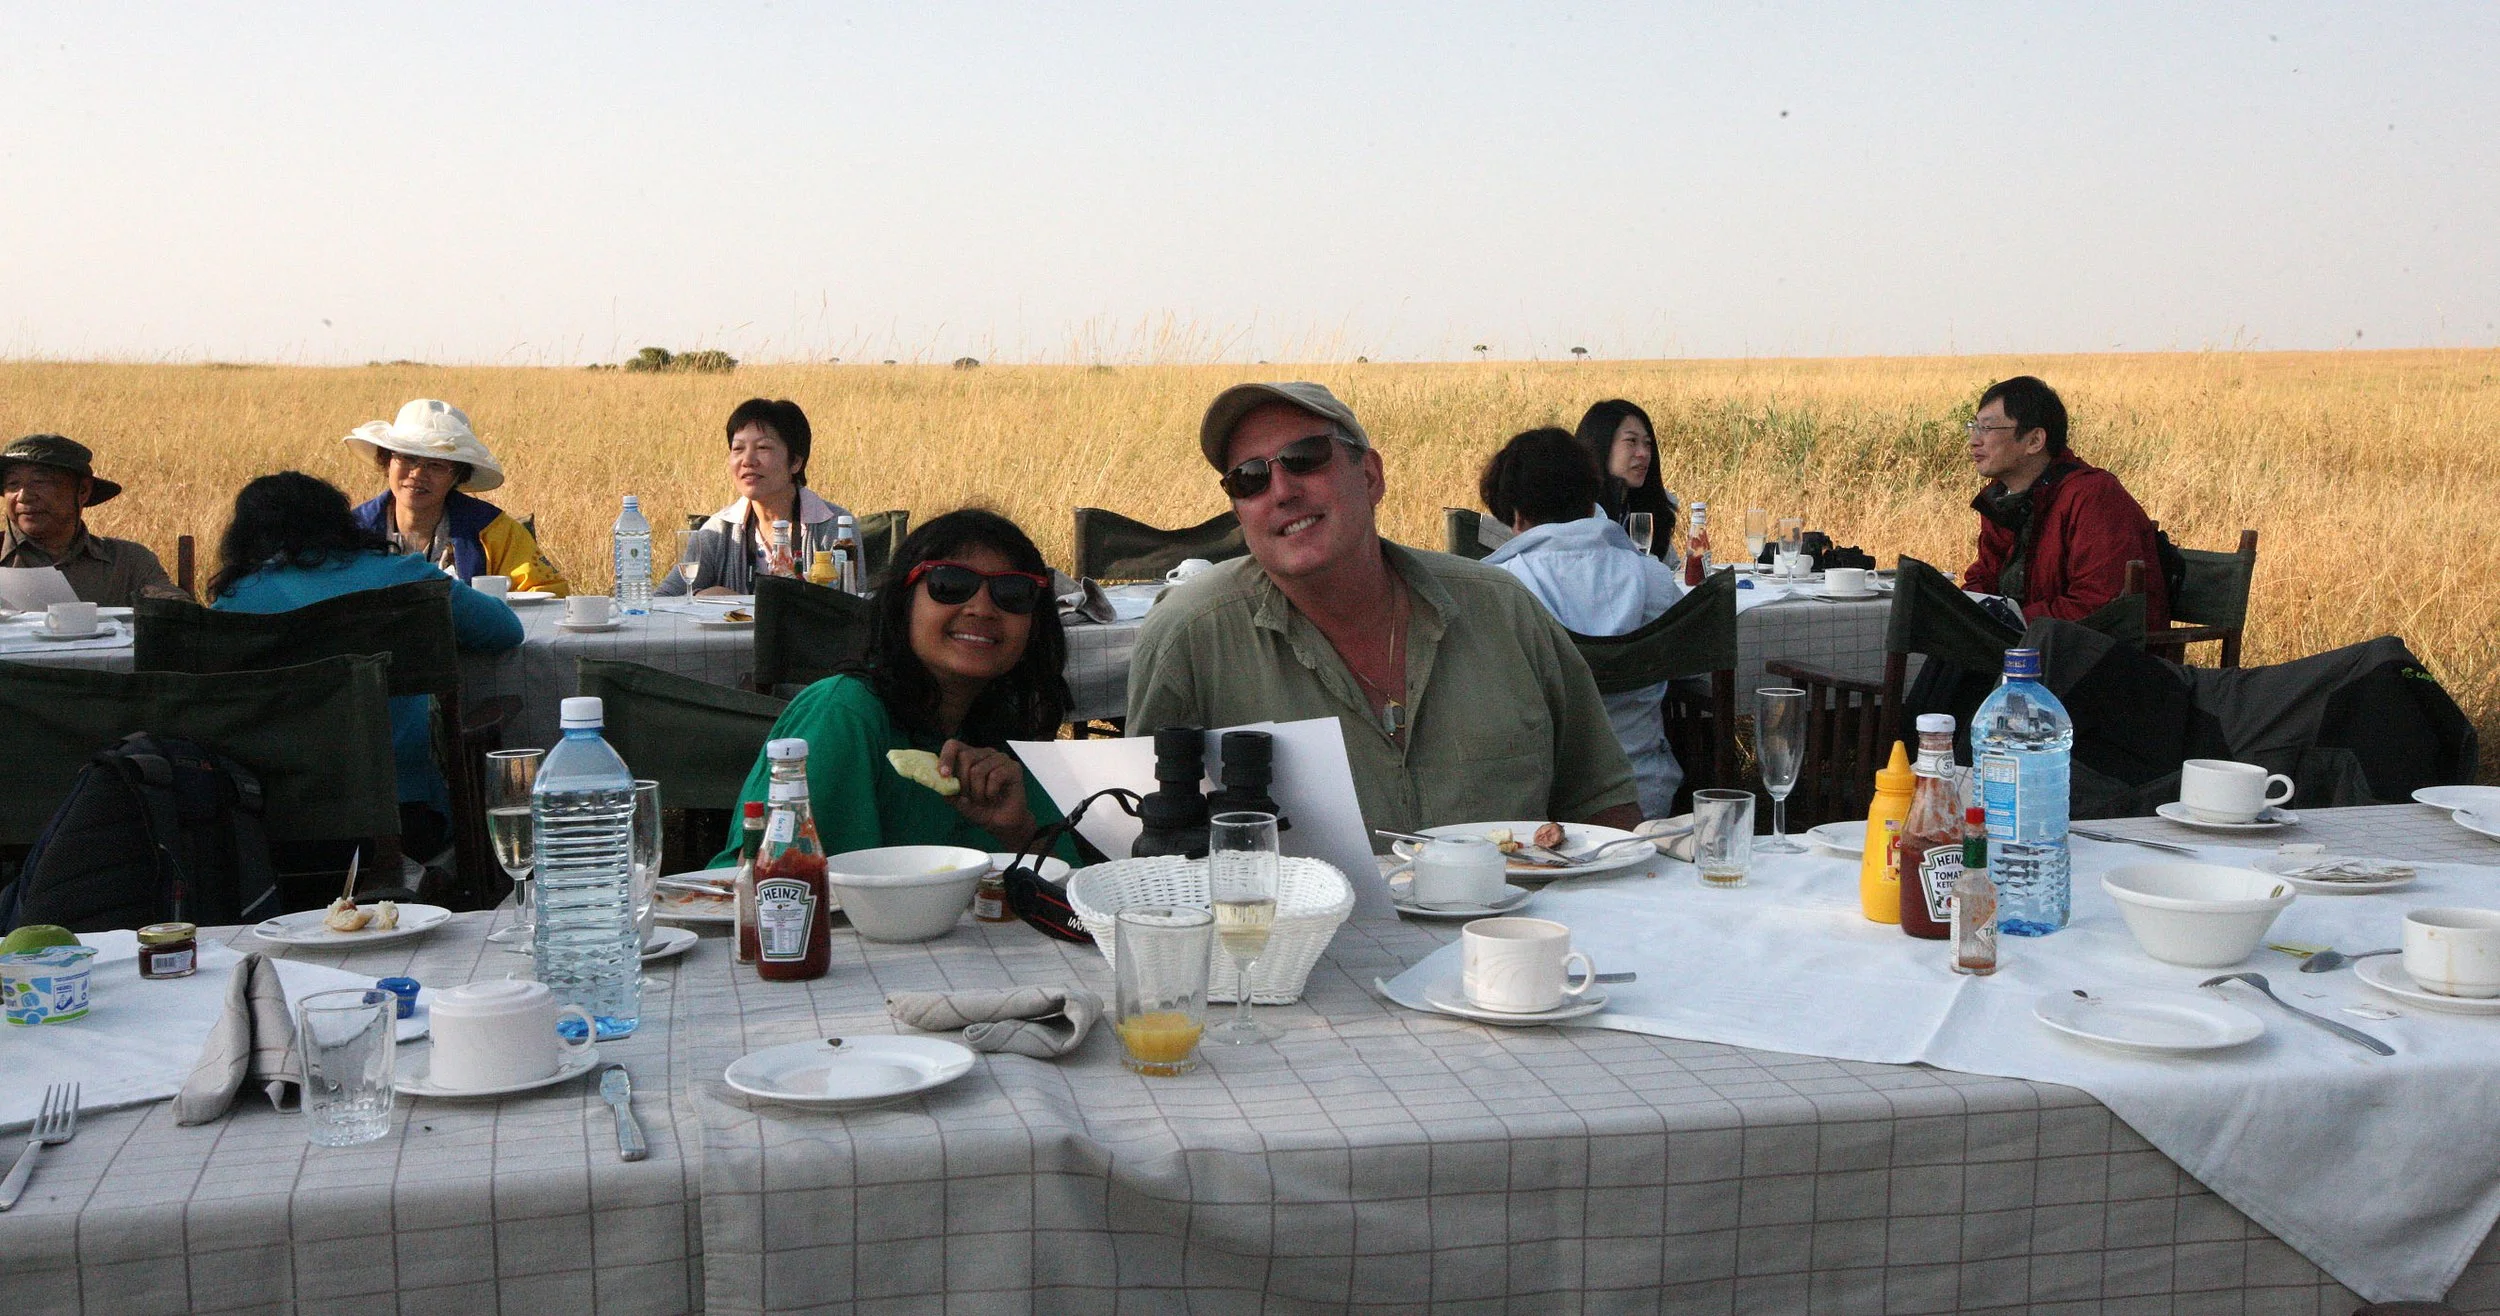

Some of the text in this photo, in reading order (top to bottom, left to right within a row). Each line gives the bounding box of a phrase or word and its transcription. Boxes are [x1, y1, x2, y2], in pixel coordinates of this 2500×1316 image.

[1936, 853, 1963, 867] HEIN
[1934, 870, 1963, 880] TOMAT
[1936, 880, 1954, 889] KETC
[763, 888, 799, 901] HEINZ
